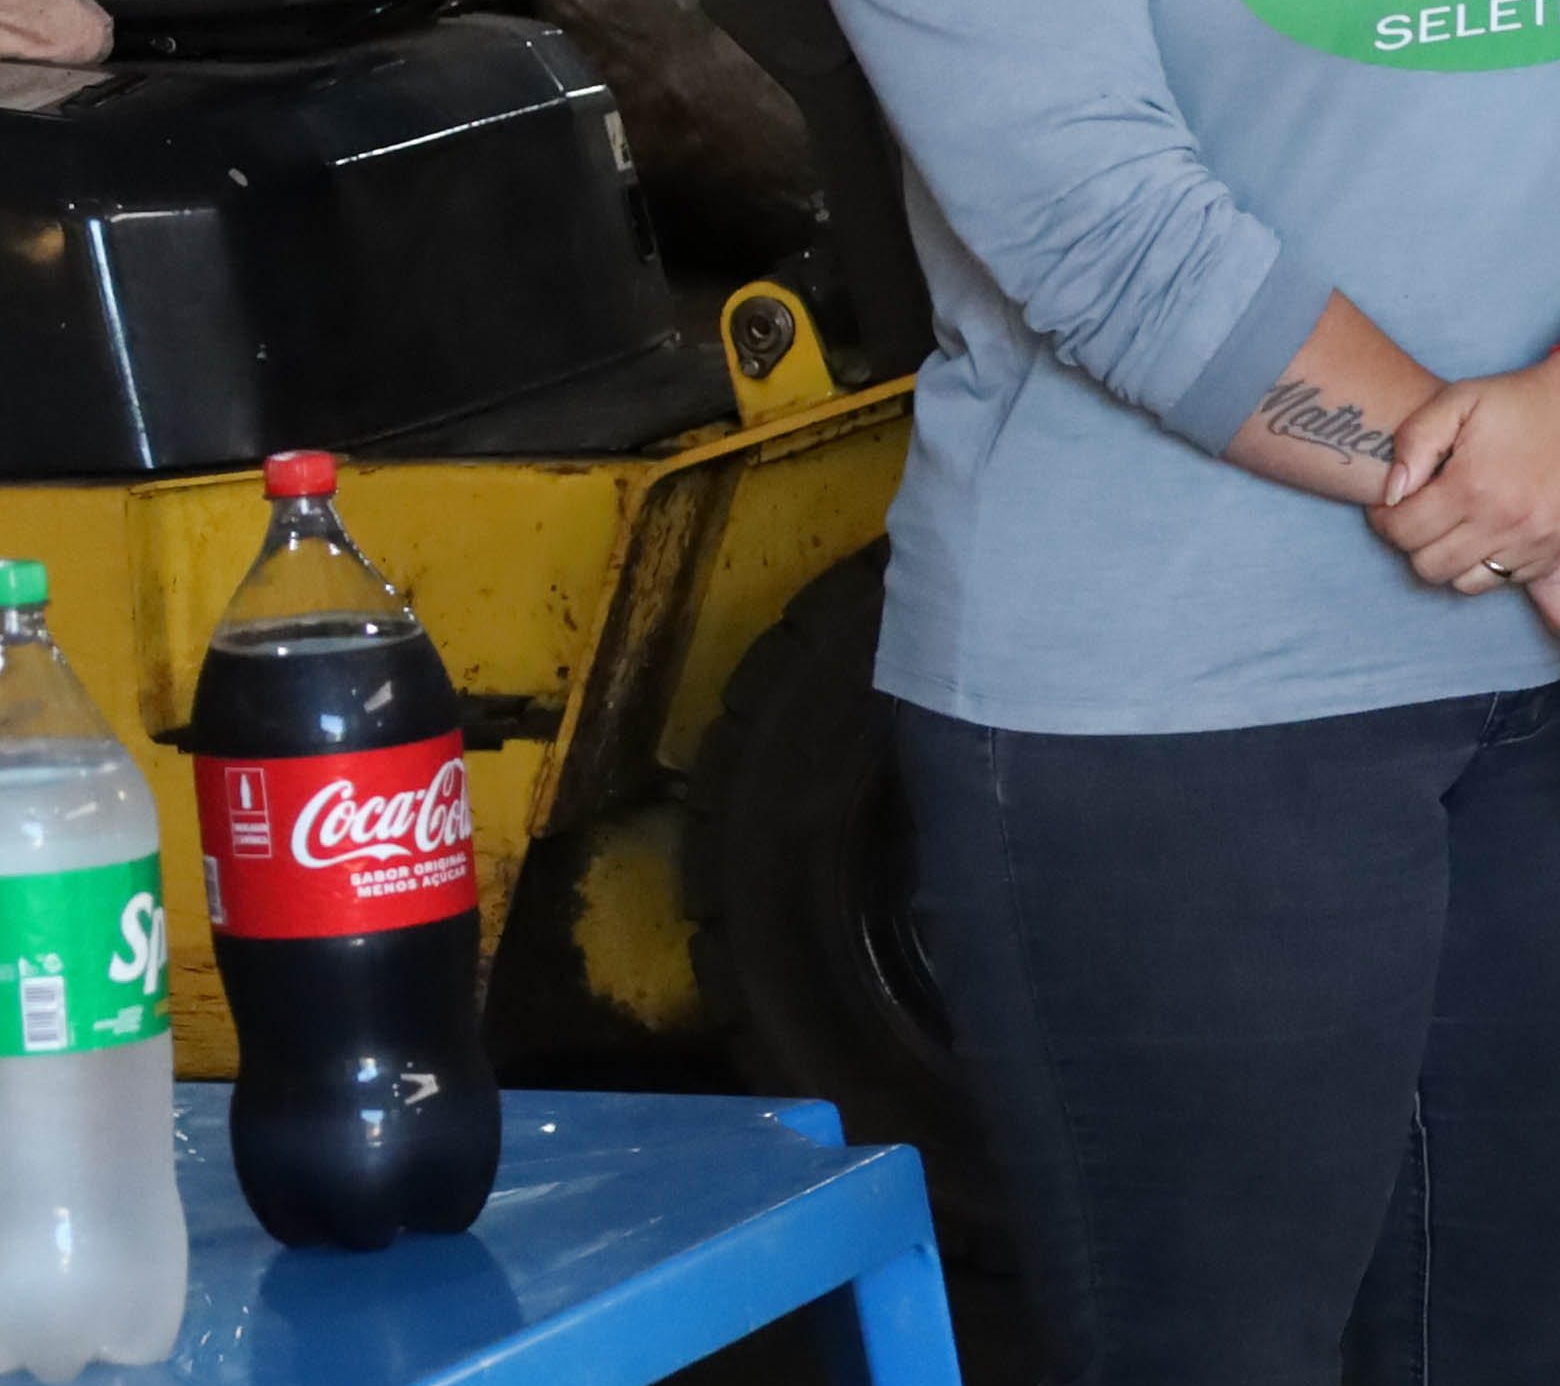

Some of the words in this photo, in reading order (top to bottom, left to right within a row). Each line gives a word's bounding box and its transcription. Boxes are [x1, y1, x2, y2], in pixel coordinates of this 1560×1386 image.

[350, 865, 410, 887] SABOR
[413, 853, 467, 876] ORIGINAL
[356, 878, 418, 899] MENOS
[421, 866, 467, 888] AÇÚCAR
